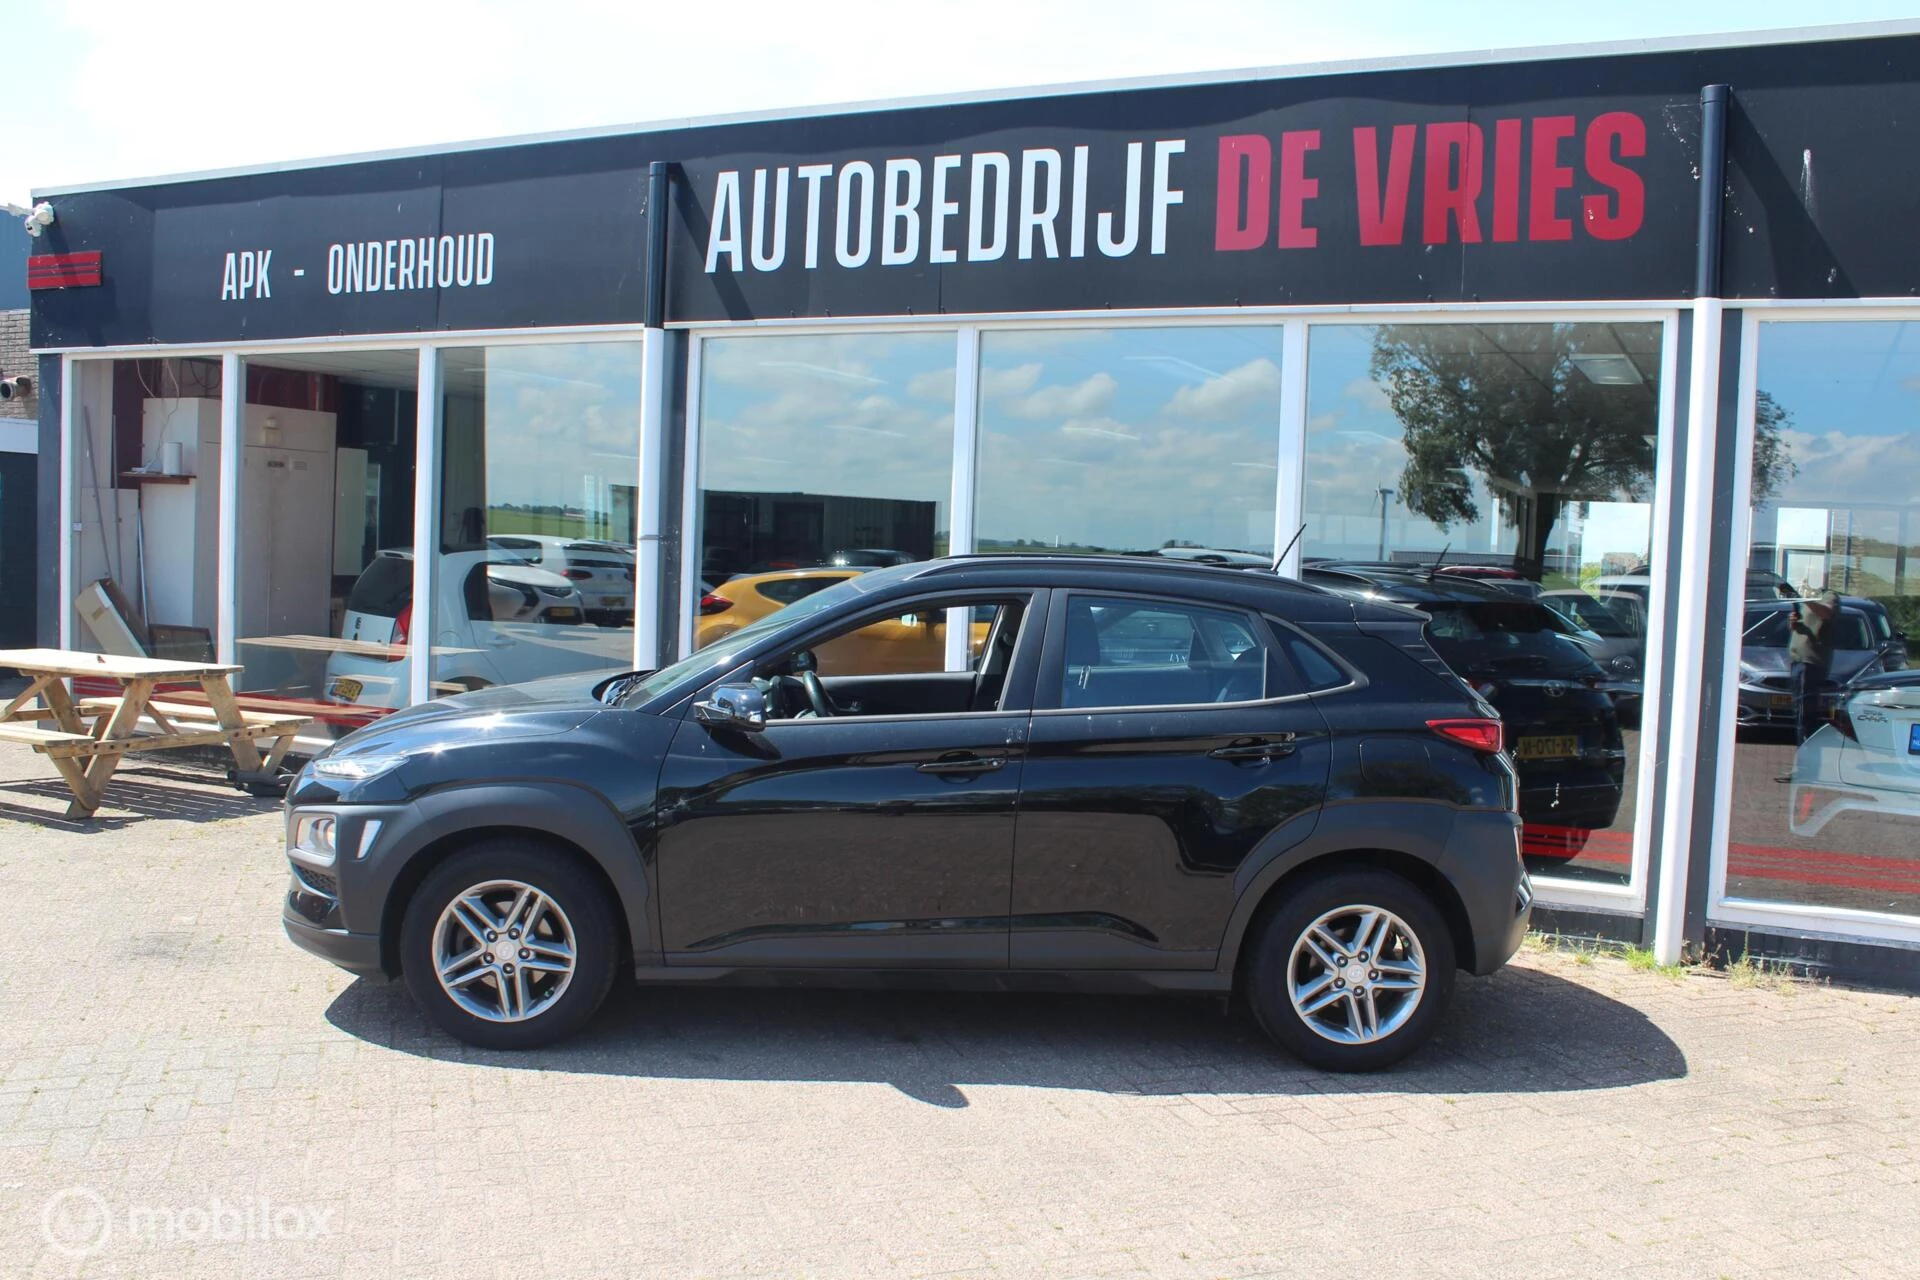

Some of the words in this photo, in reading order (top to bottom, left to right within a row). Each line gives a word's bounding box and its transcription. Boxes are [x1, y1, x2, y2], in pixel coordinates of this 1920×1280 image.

[704, 139, 1186, 274] AUTOBEDRIJF
[1215, 130, 1321, 251] DE
[1353, 111, 1647, 246] VRIES
[221, 249, 272, 301] APK
[327, 232, 494, 295] ONDERHOUD
